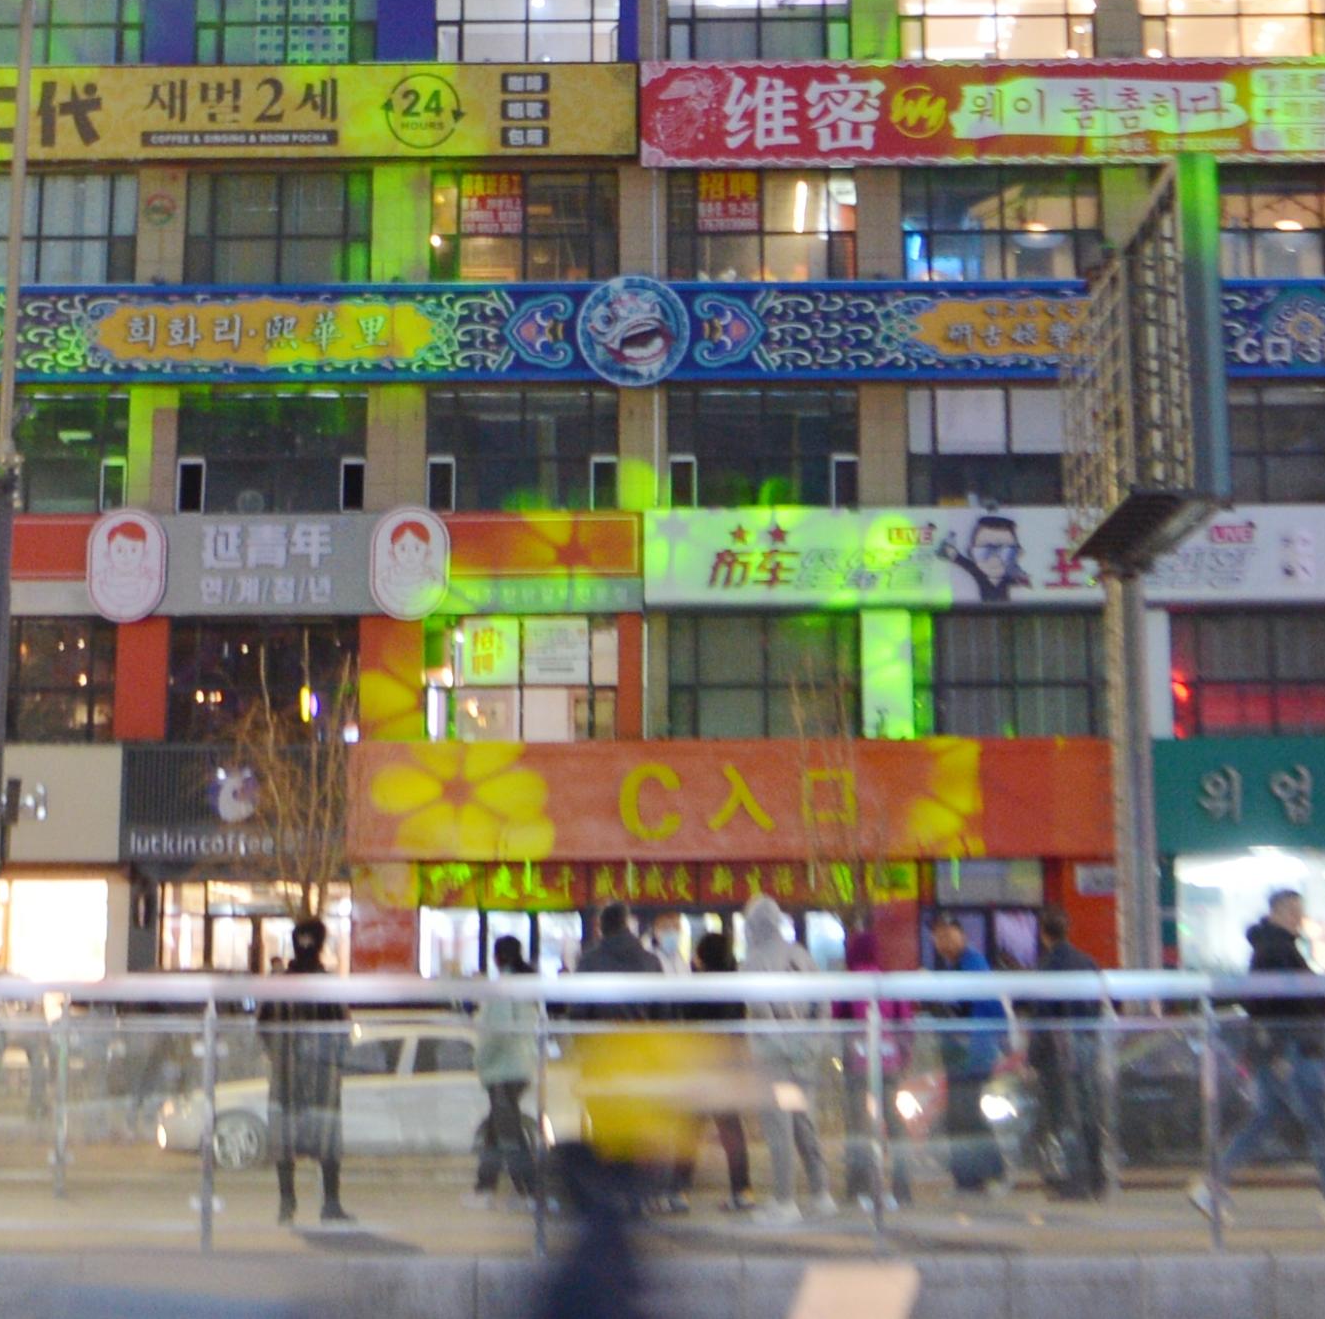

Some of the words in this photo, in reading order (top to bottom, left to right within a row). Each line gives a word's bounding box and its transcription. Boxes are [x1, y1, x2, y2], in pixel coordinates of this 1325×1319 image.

[401, 121, 446, 131] HOURS
[402, 89, 443, 118] 24
[723, 73, 885, 151] 维密
[708, 764, 858, 832] 入口
